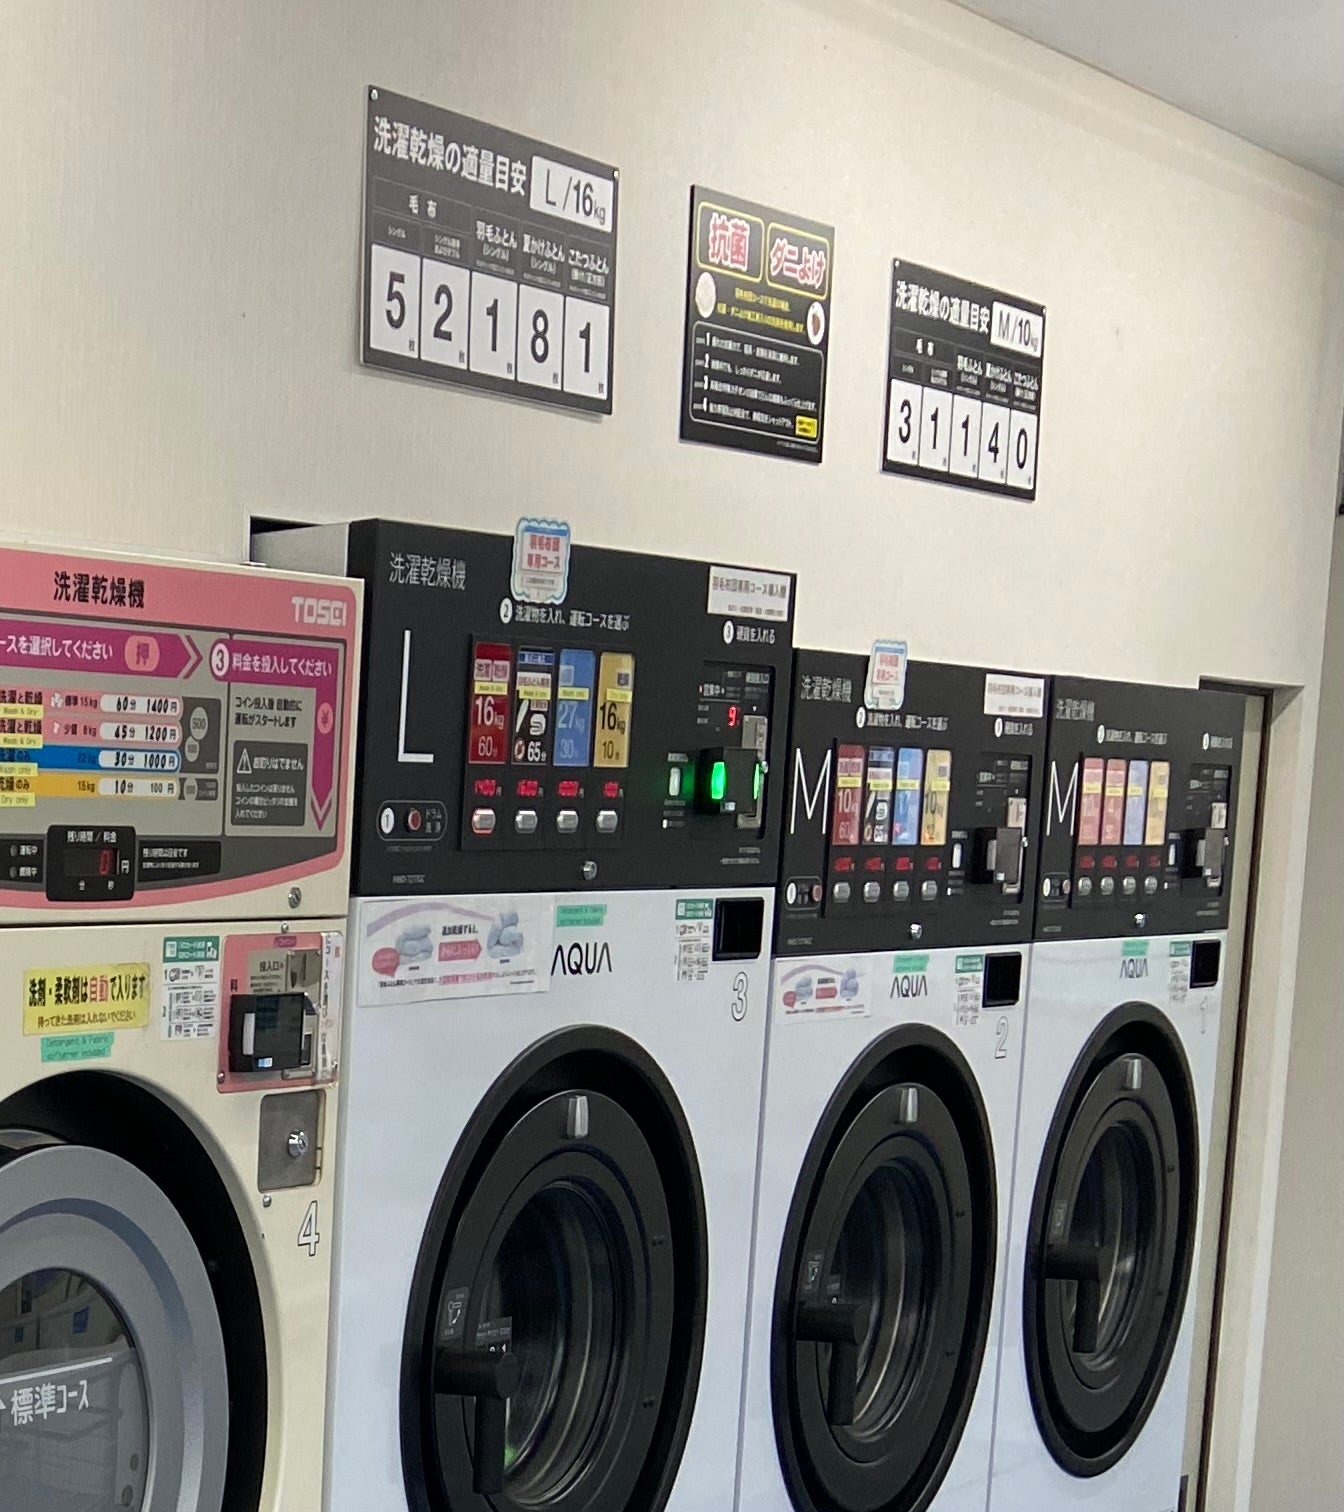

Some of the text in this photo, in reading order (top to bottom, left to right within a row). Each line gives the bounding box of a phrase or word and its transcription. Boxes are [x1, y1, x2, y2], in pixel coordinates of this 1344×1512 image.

[373, 116, 526, 197] 洗濯乾燥の適量目安
[546, 168, 556, 206] L
[476, 220, 517, 249] 羽毛ふとん
[523, 234, 565, 262] 夏かけふとん
[709, 212, 750, 271] 抗菌
[568, 249, 609, 274] こたつふとん
[770, 238, 826, 289] ダニよけ
[386, 271, 405, 329] 5
[433, 284, 453, 342] 2
[486, 298, 498, 352] 1
[531, 309, 549, 363] 8
[998, 310, 1010, 340] M
[579, 322, 591, 373] 1
[899, 399, 911, 443] 3
[931, 407, 938, 449] 1
[962, 414, 969, 456] 1
[988, 422, 999, 463] 4
[1017, 428, 1027, 469] 0
[53, 569, 145, 609] 洗濯乾燥機
[390, 552, 467, 591] 洗濯乾燥機
[291, 596, 347, 627] TOSEI
[232, 652, 332, 677] 料金を投入してください
[397, 629, 435, 763] L
[790, 748, 832, 835] M
[1045, 760, 1079, 836] M
[550, 942, 613, 977] AQUA
[1119, 958, 1149, 979] AQUA
[730, 971, 749, 1022] 3
[889, 974, 929, 999] AQUA
[994, 1016, 1010, 1060] 2
[296, 1200, 320, 1258] 4
[9, 1378, 89, 1427] 標準コース
